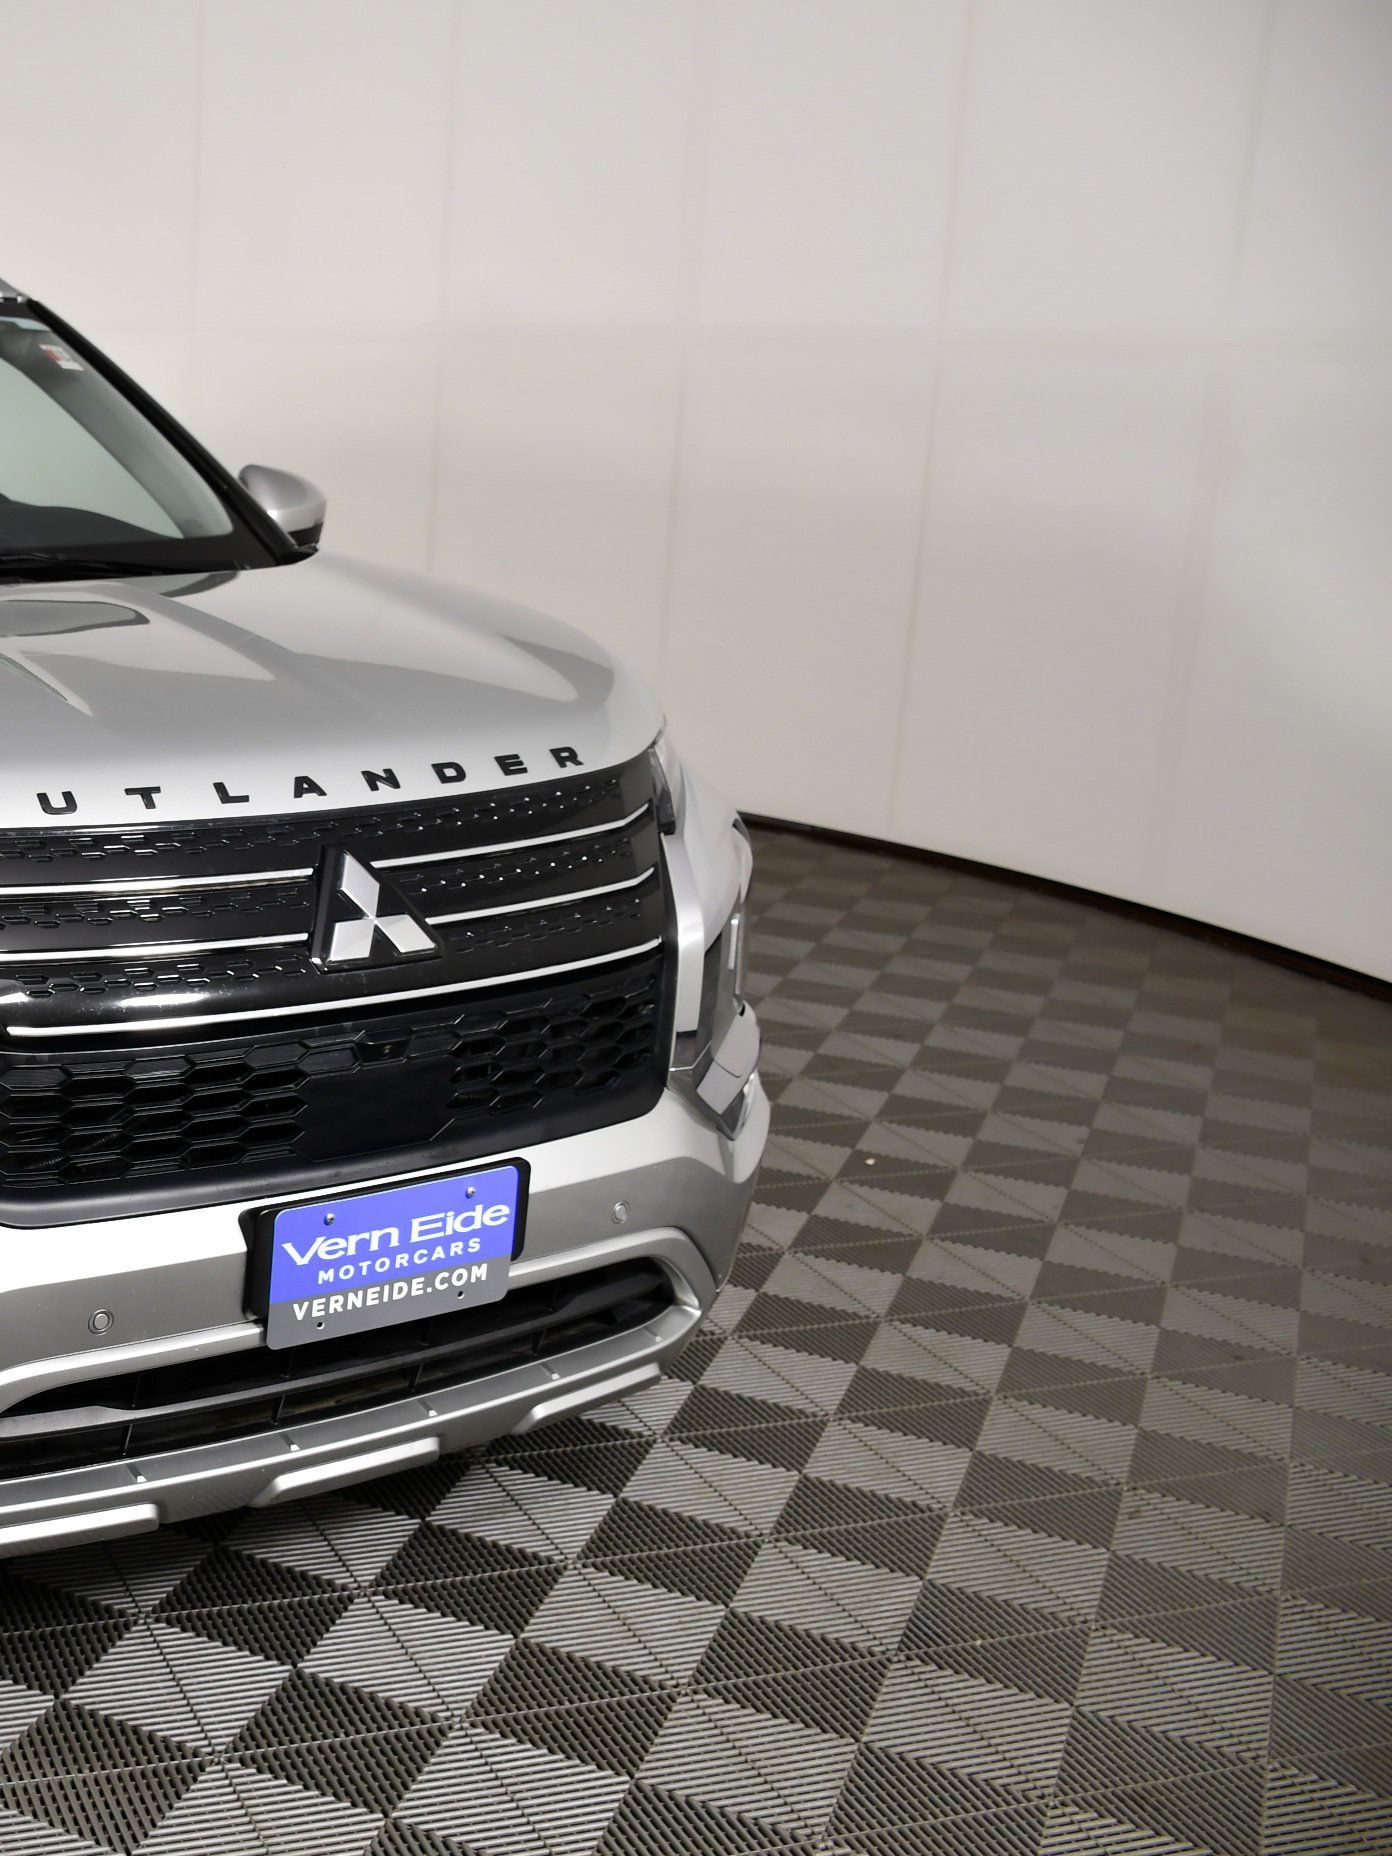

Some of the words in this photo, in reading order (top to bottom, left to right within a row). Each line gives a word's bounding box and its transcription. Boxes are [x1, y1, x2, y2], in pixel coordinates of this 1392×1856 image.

[282, 1226, 400, 1265] Vern
[408, 1204, 510, 1243] Eide
[317, 1237, 482, 1284] MOTORCARS
[292, 1262, 488, 1321] VERNEIDE.COM
